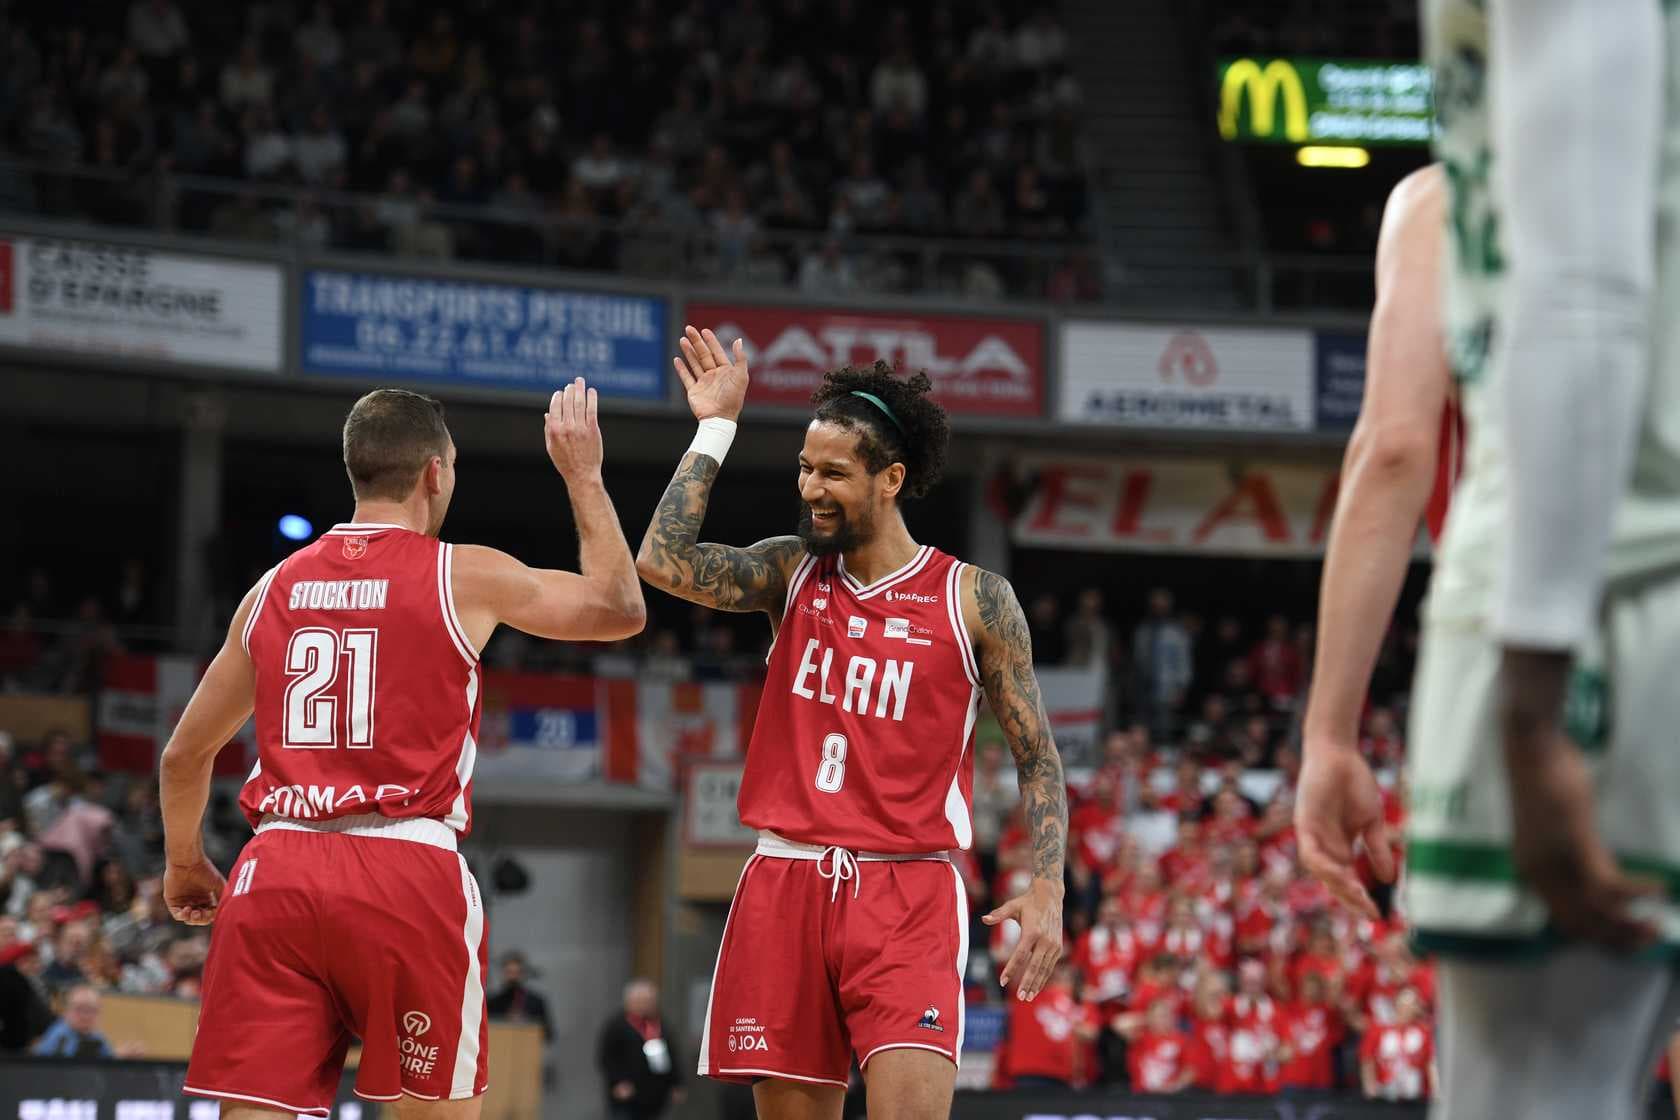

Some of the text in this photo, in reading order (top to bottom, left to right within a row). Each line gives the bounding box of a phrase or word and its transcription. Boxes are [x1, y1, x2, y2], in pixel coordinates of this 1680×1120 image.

[313, 273, 524, 330] TRANSPORTS
[288, 579, 389, 611] STOCKTON
[899, 593, 939, 603] PAPREC
[282, 626, 379, 750] 21
[791, 638, 914, 721] ELAN
[815, 733, 848, 794] 8
[232, 858, 258, 898] 21
[735, 1017, 756, 1025] CASINO
[738, 1034, 769, 1051] JOA
